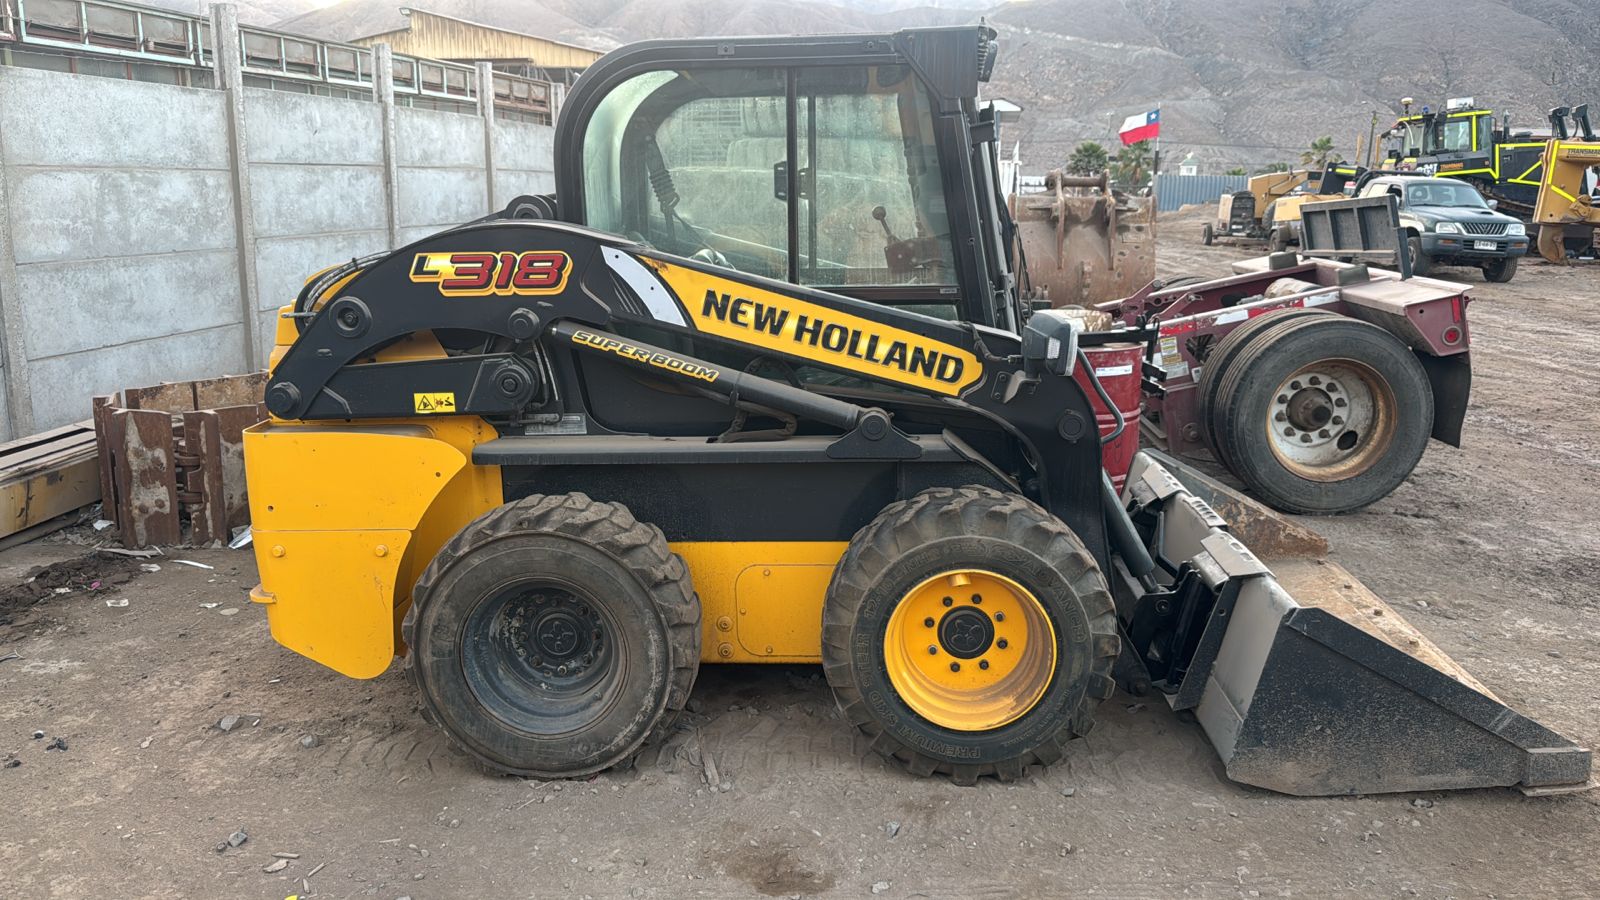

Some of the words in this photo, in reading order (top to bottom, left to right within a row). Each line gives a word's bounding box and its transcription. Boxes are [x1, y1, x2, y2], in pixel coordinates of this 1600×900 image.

[411, 252, 571, 295] L318
[572, 330, 650, 363] SUPER
[650, 353, 719, 382] BOOM
[702, 289, 790, 336] NEW
[793, 314, 965, 385] HOLLAND
[856, 633, 872, 688] STEER
[869, 690, 898, 727] SKID
[898, 725, 981, 759] PREMIUM
